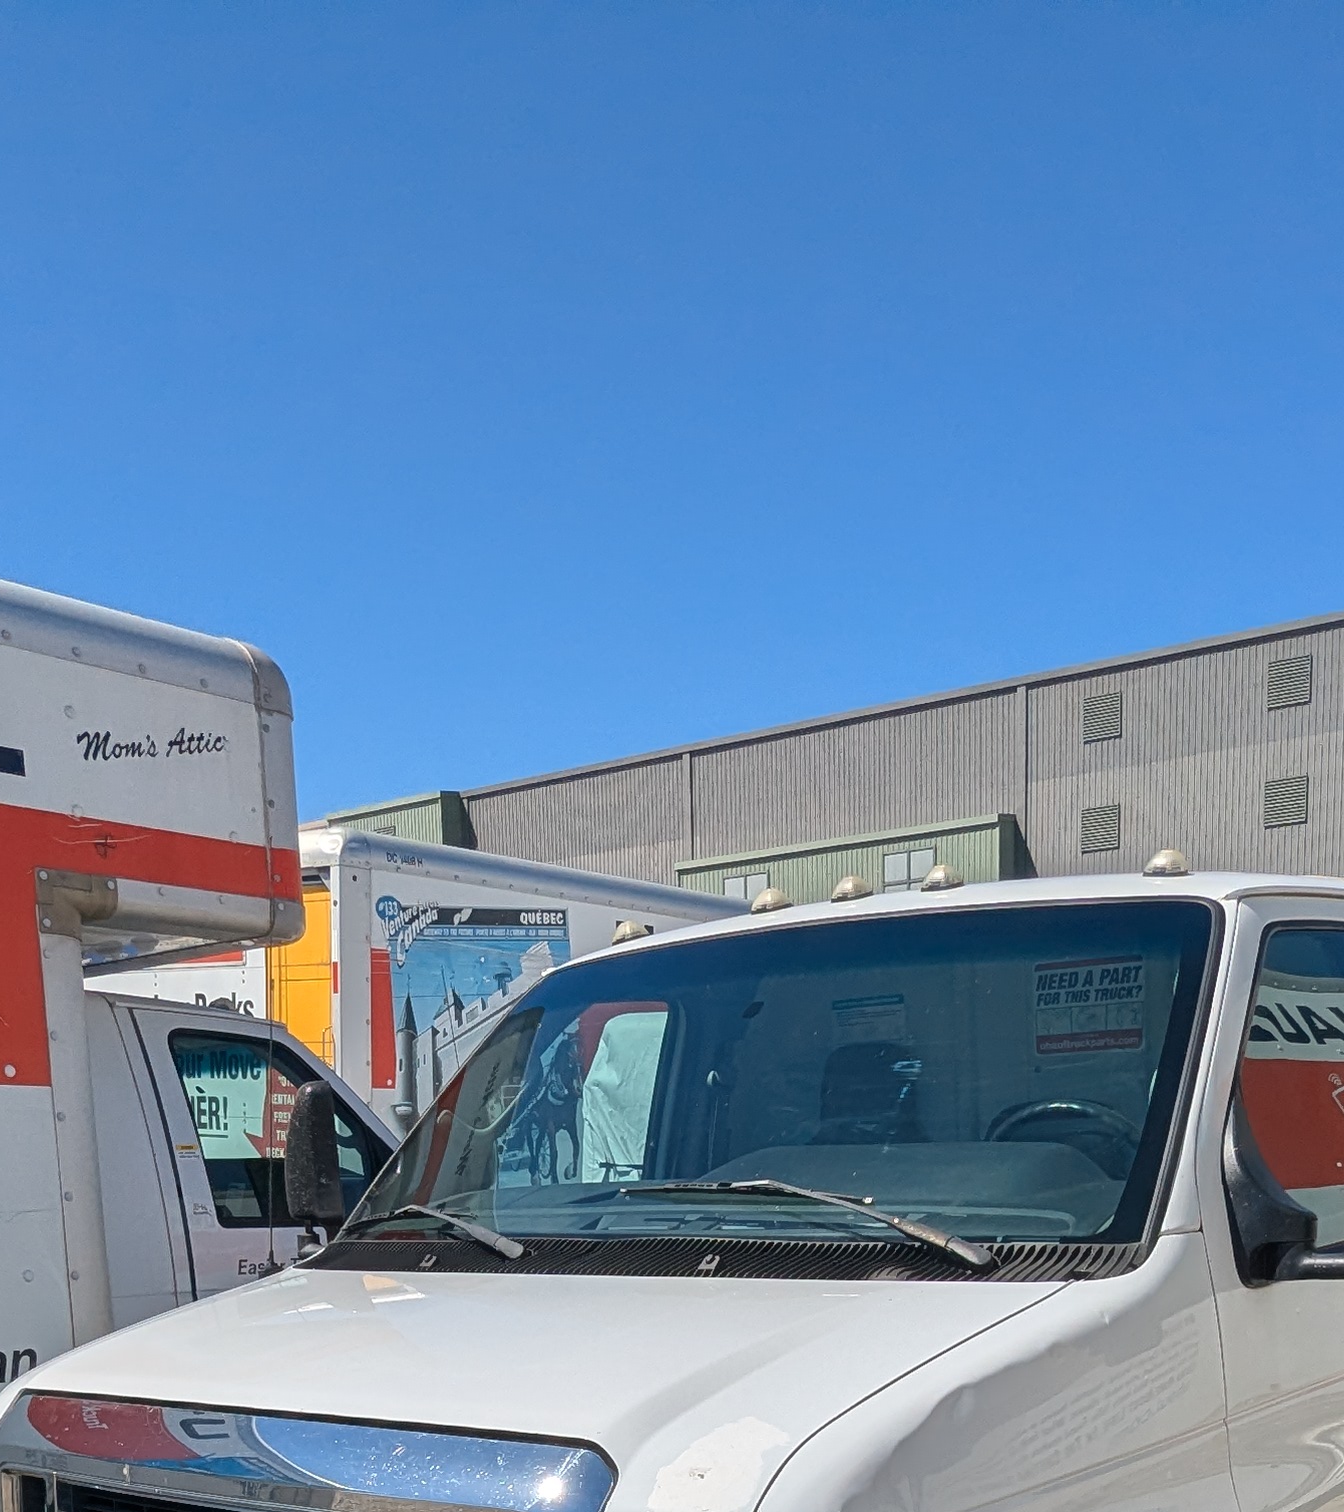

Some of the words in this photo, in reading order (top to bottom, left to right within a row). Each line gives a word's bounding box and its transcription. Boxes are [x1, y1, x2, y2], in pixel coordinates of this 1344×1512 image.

[76, 730, 159, 761] Mom's
[519, 909, 564, 925] QUÉBEC
[1036, 972, 1079, 992] NEED
[1082, 969, 1093, 988] A
[1099, 965, 1143, 987] PART
[1037, 992, 1061, 1007] FOR
[1065, 988, 1091, 1004] THIS
[1094, 984, 1143, 1002] TRUCK?
[210, 1051, 261, 1081] Move
